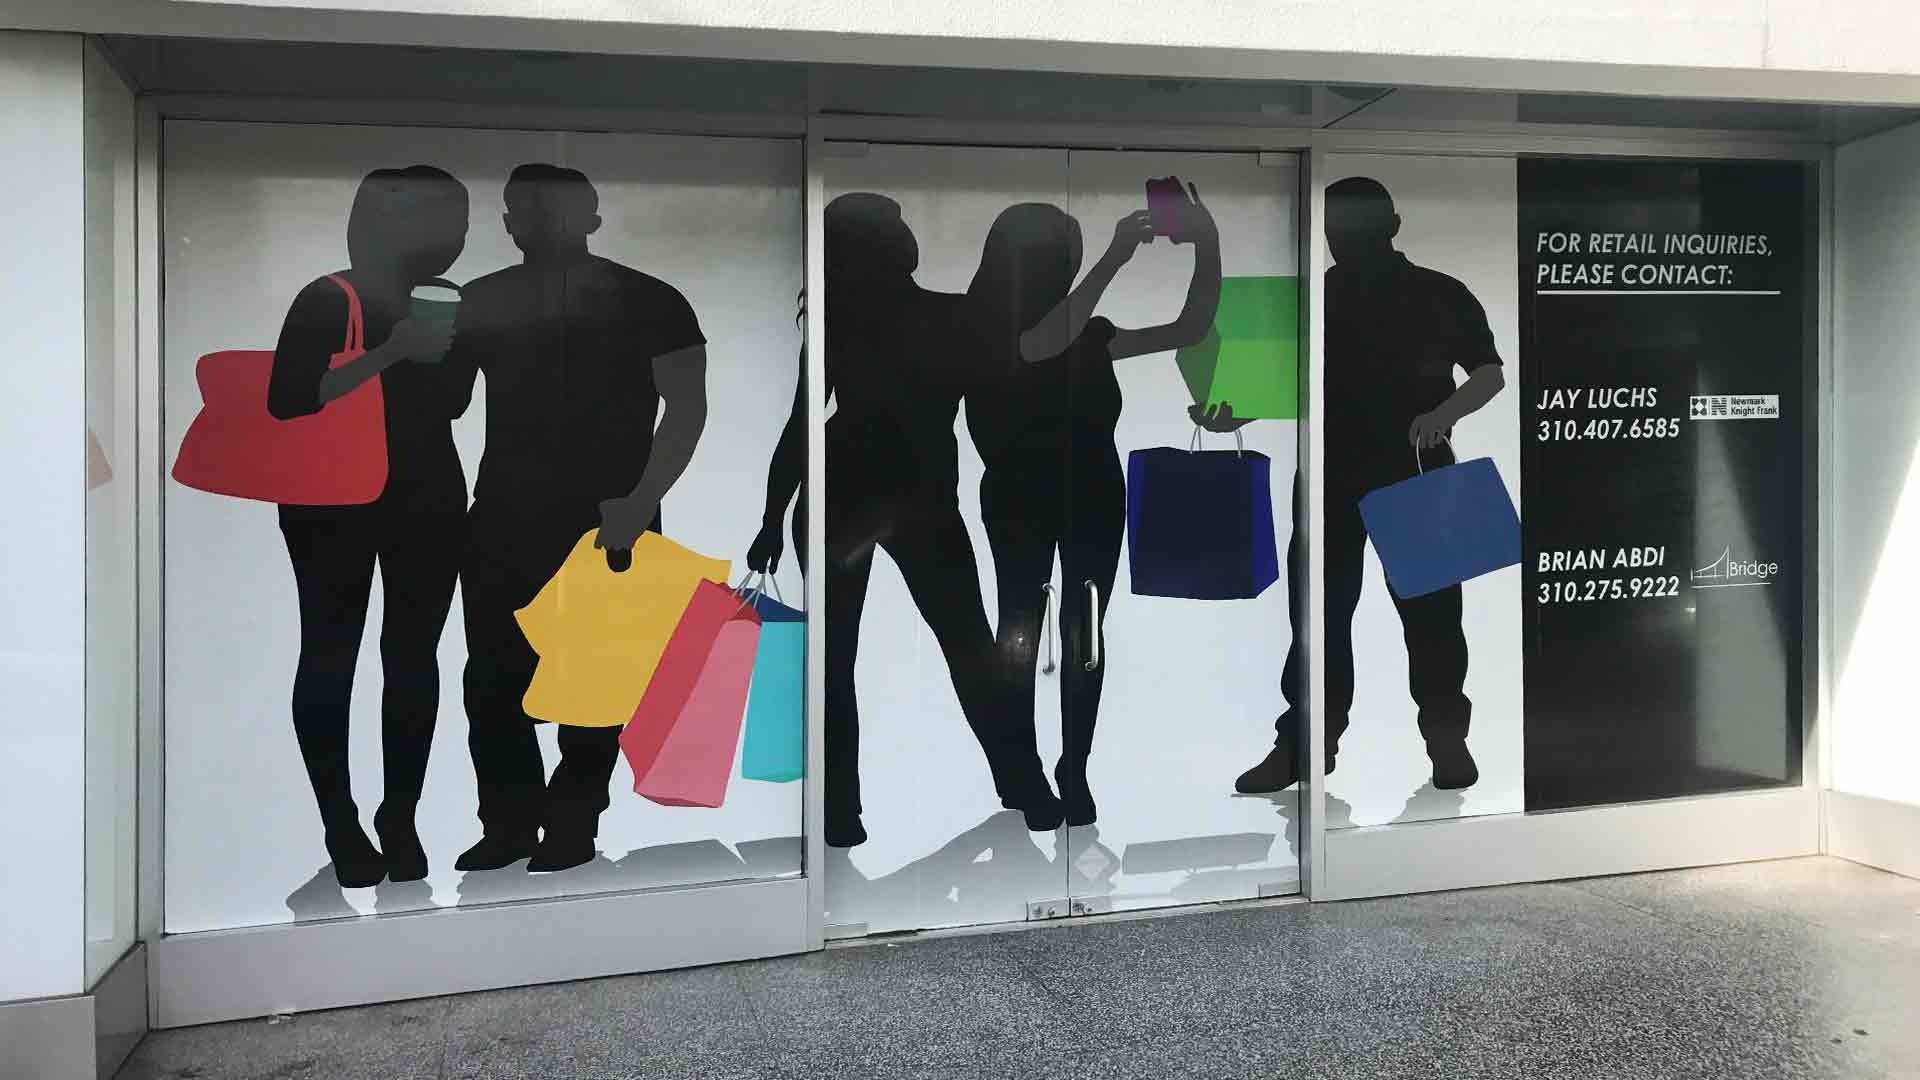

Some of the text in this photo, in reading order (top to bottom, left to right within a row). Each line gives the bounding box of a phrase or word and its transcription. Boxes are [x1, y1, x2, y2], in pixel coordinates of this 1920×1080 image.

[1536, 232, 1773, 256] FOR RETAIL INQUIRIES,
[1536, 264, 1734, 285] PLEASE CONTACT:
[1536, 387, 1658, 410] JAY LUCHS
[1730, 396, 1766, 405] Newmark
[1730, 405, 1778, 417] Knight Frank
[1537, 418, 1680, 441] 310.407.6585
[1537, 546, 1665, 573] BRIAN ABDI
[1729, 560, 1778, 577] Bridge
[1537, 576, 1680, 604] 310.275.9222
